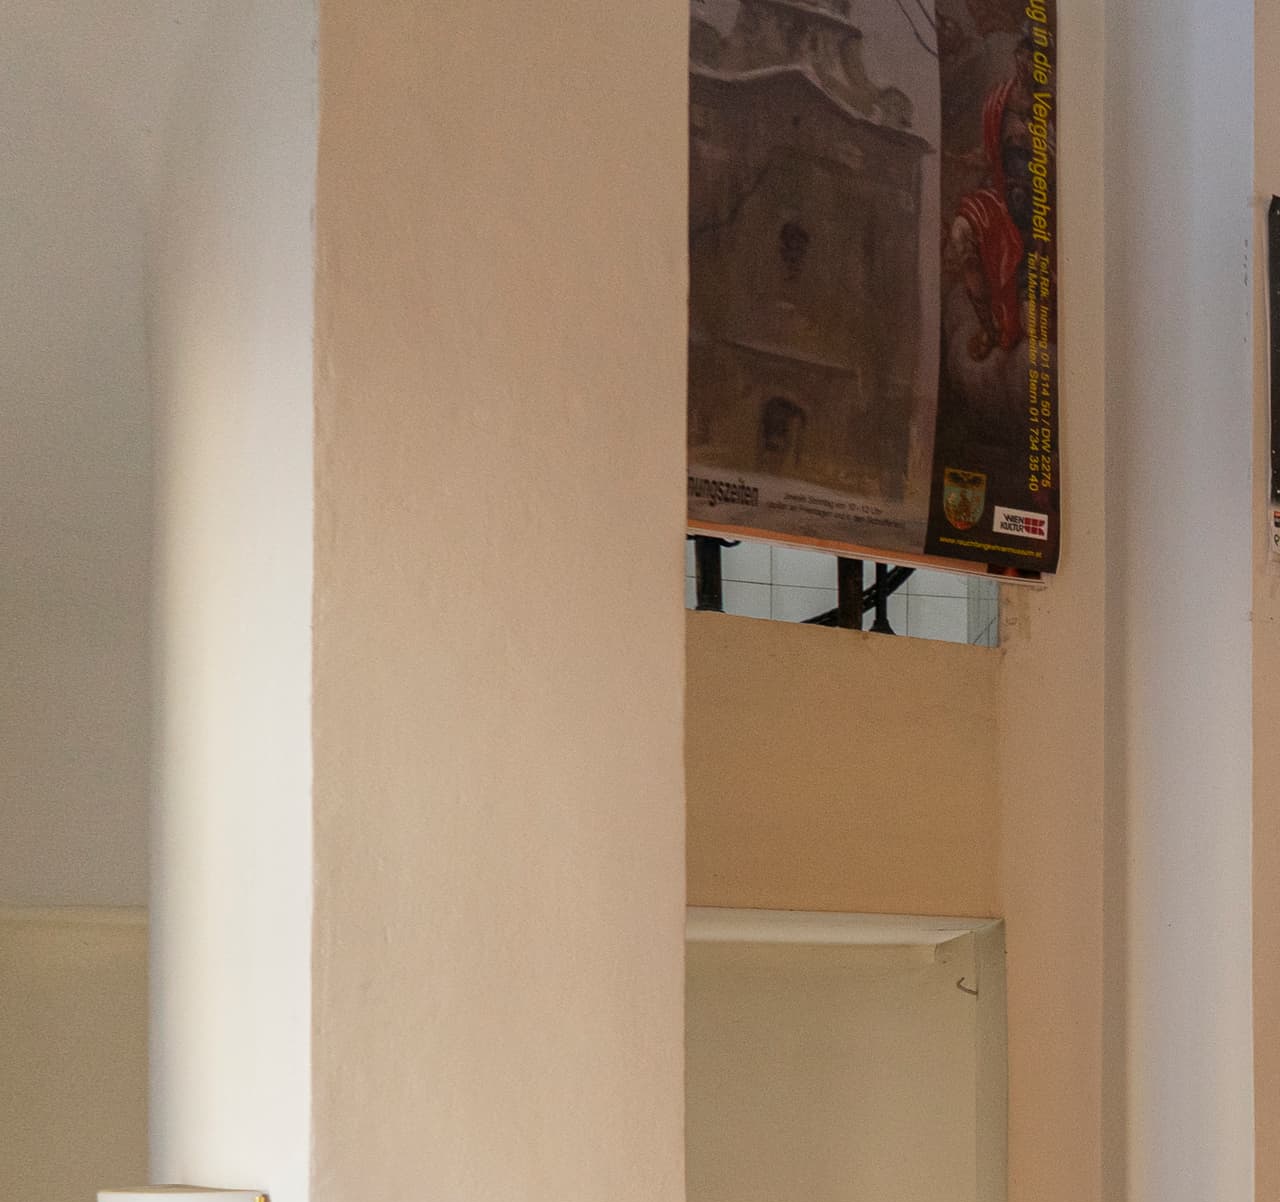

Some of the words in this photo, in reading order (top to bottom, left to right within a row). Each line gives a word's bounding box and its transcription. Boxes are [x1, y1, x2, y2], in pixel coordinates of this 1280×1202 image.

[1032, 26, 1048, 47] in
[1033, 51, 1051, 85] die
[1028, 92, 1050, 243] Vergangenheit
[1041, 400, 1050, 416] 50
[1029, 428, 1038, 451] 734
[1029, 456, 1038, 472] 35
[1041, 456, 1051, 488] 2275
[1028, 475, 1039, 492] 40
